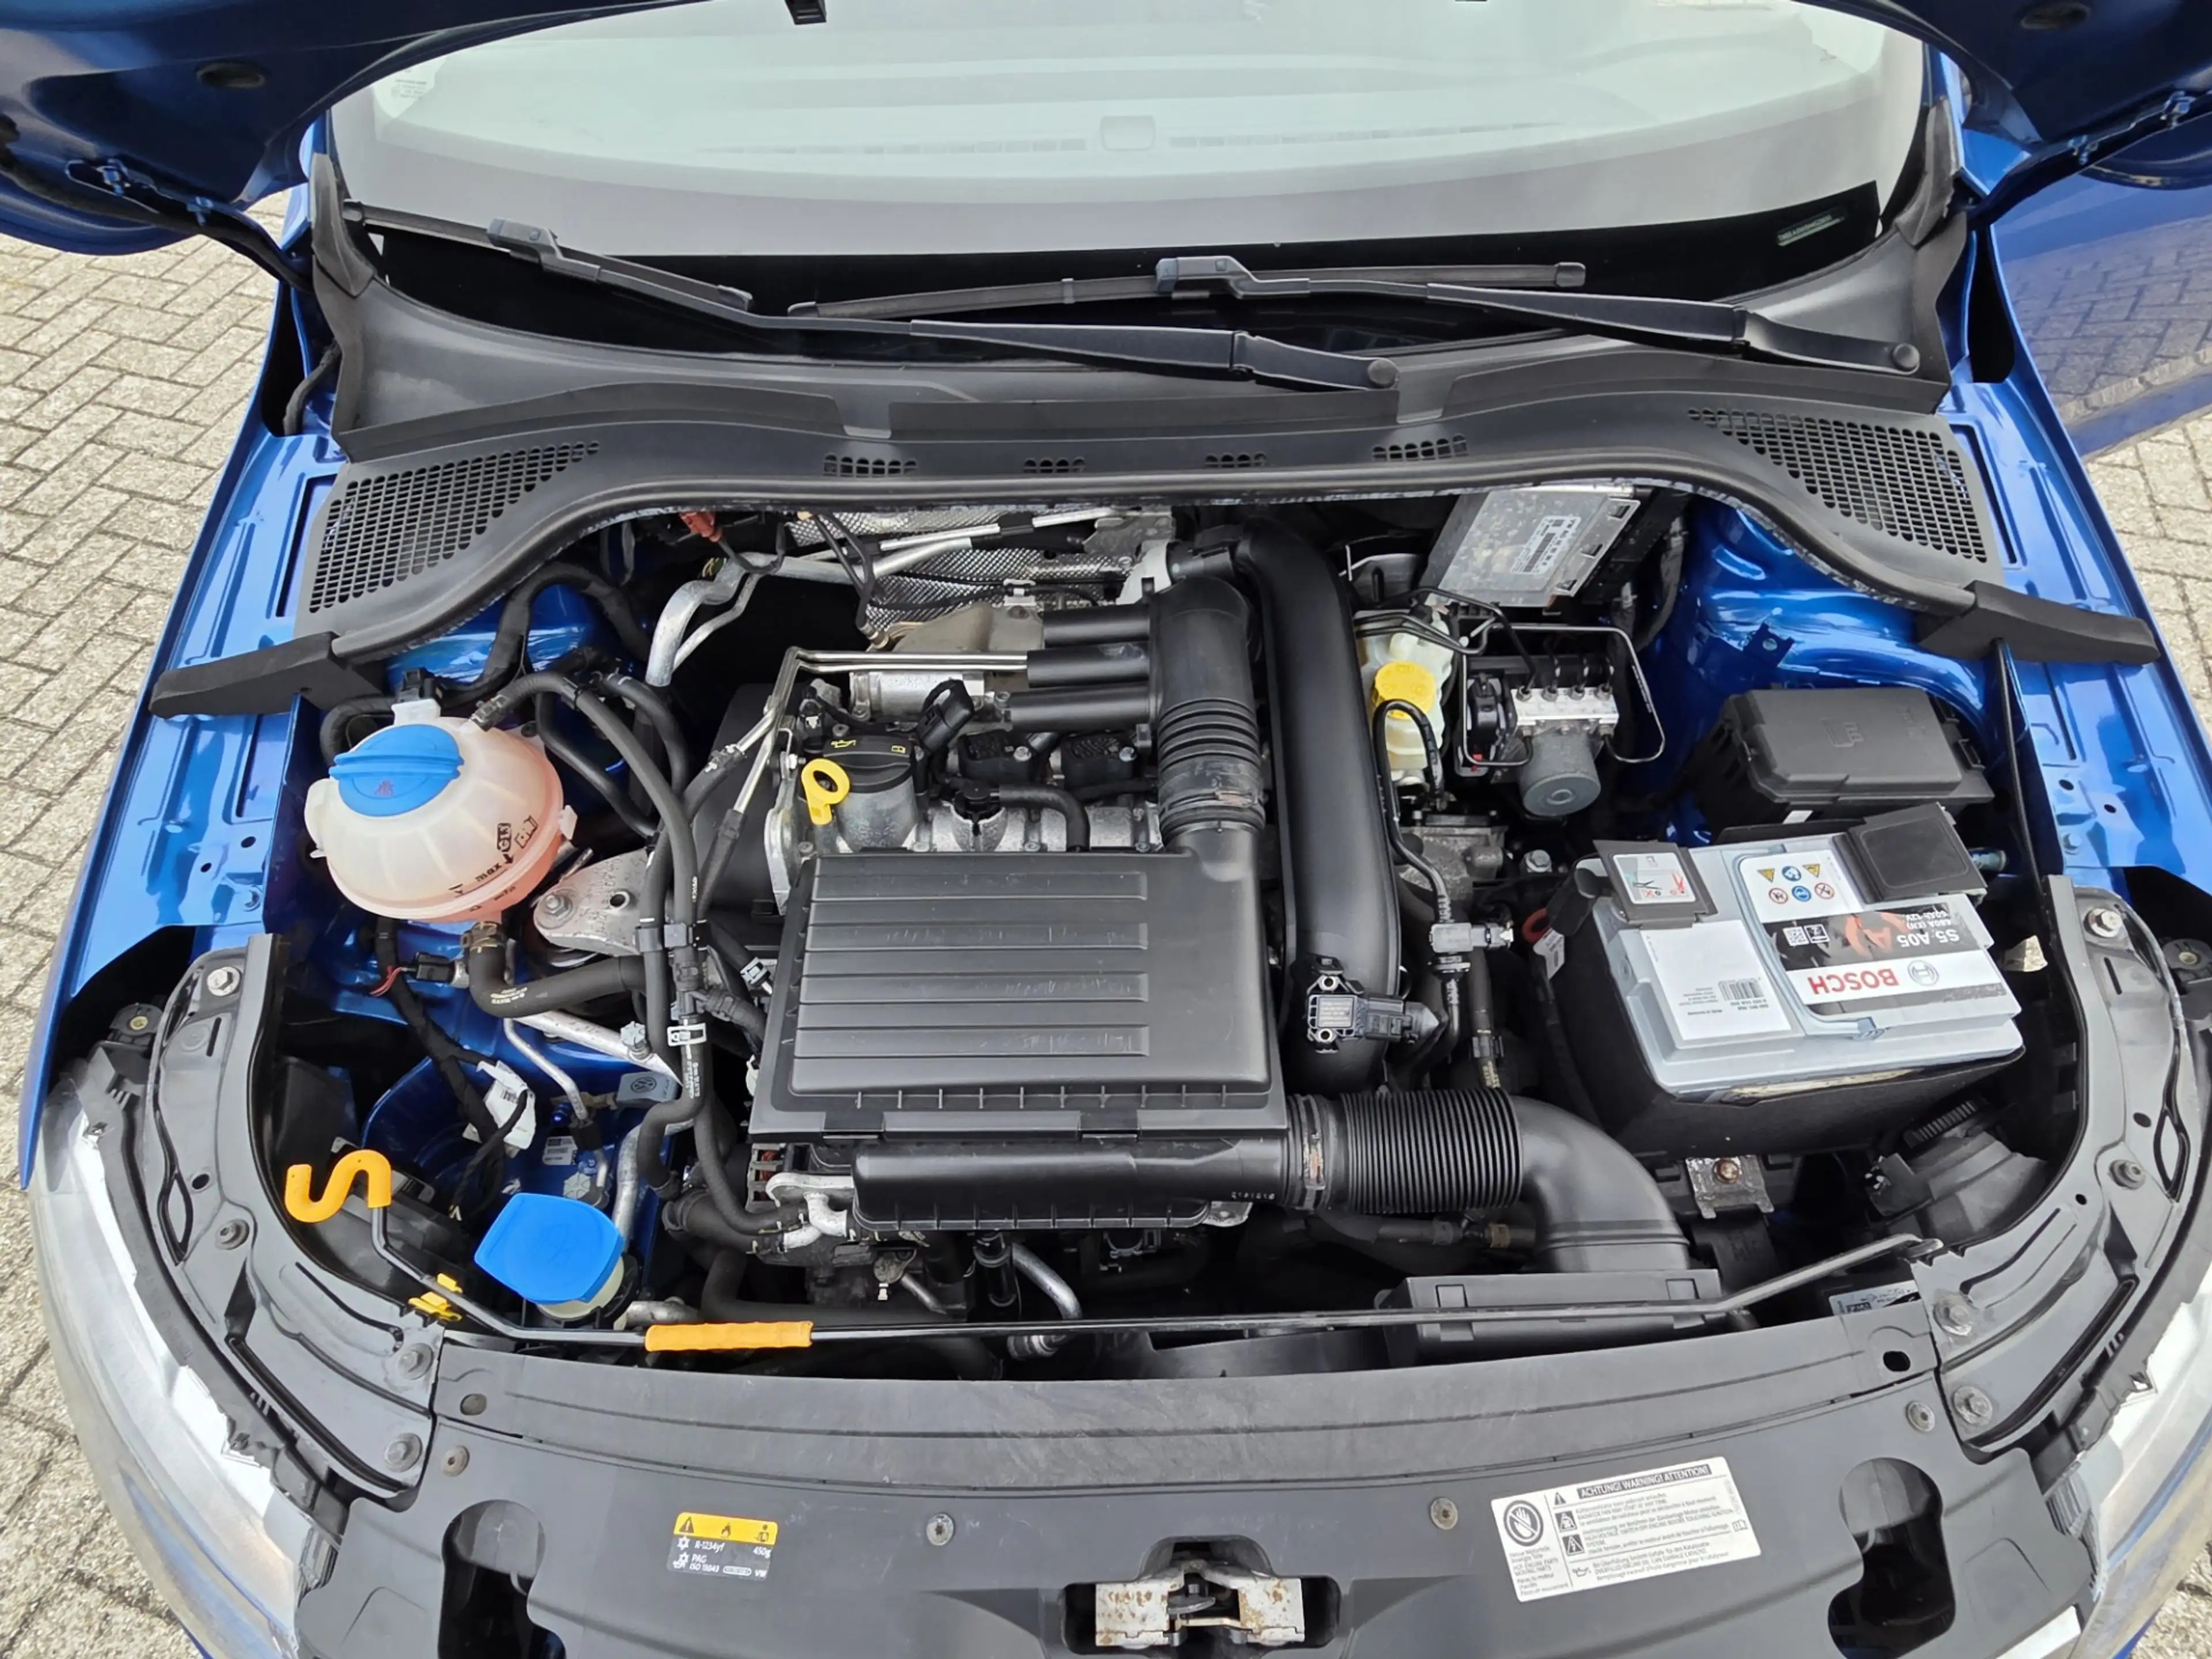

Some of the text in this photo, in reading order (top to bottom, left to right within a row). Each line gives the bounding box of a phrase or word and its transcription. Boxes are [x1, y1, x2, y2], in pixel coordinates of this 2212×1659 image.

[475, 862, 502, 882] max
[1896, 929, 1960, 948] S5 A05
[1808, 968, 1900, 995] BOSCH
[1621, 1473, 1664, 1489] WARNING!
[1661, 1464, 1709, 1482] ATTENTION!
[689, 1563, 700, 1571] ISO
[691, 1554, 707, 1563] PAG
